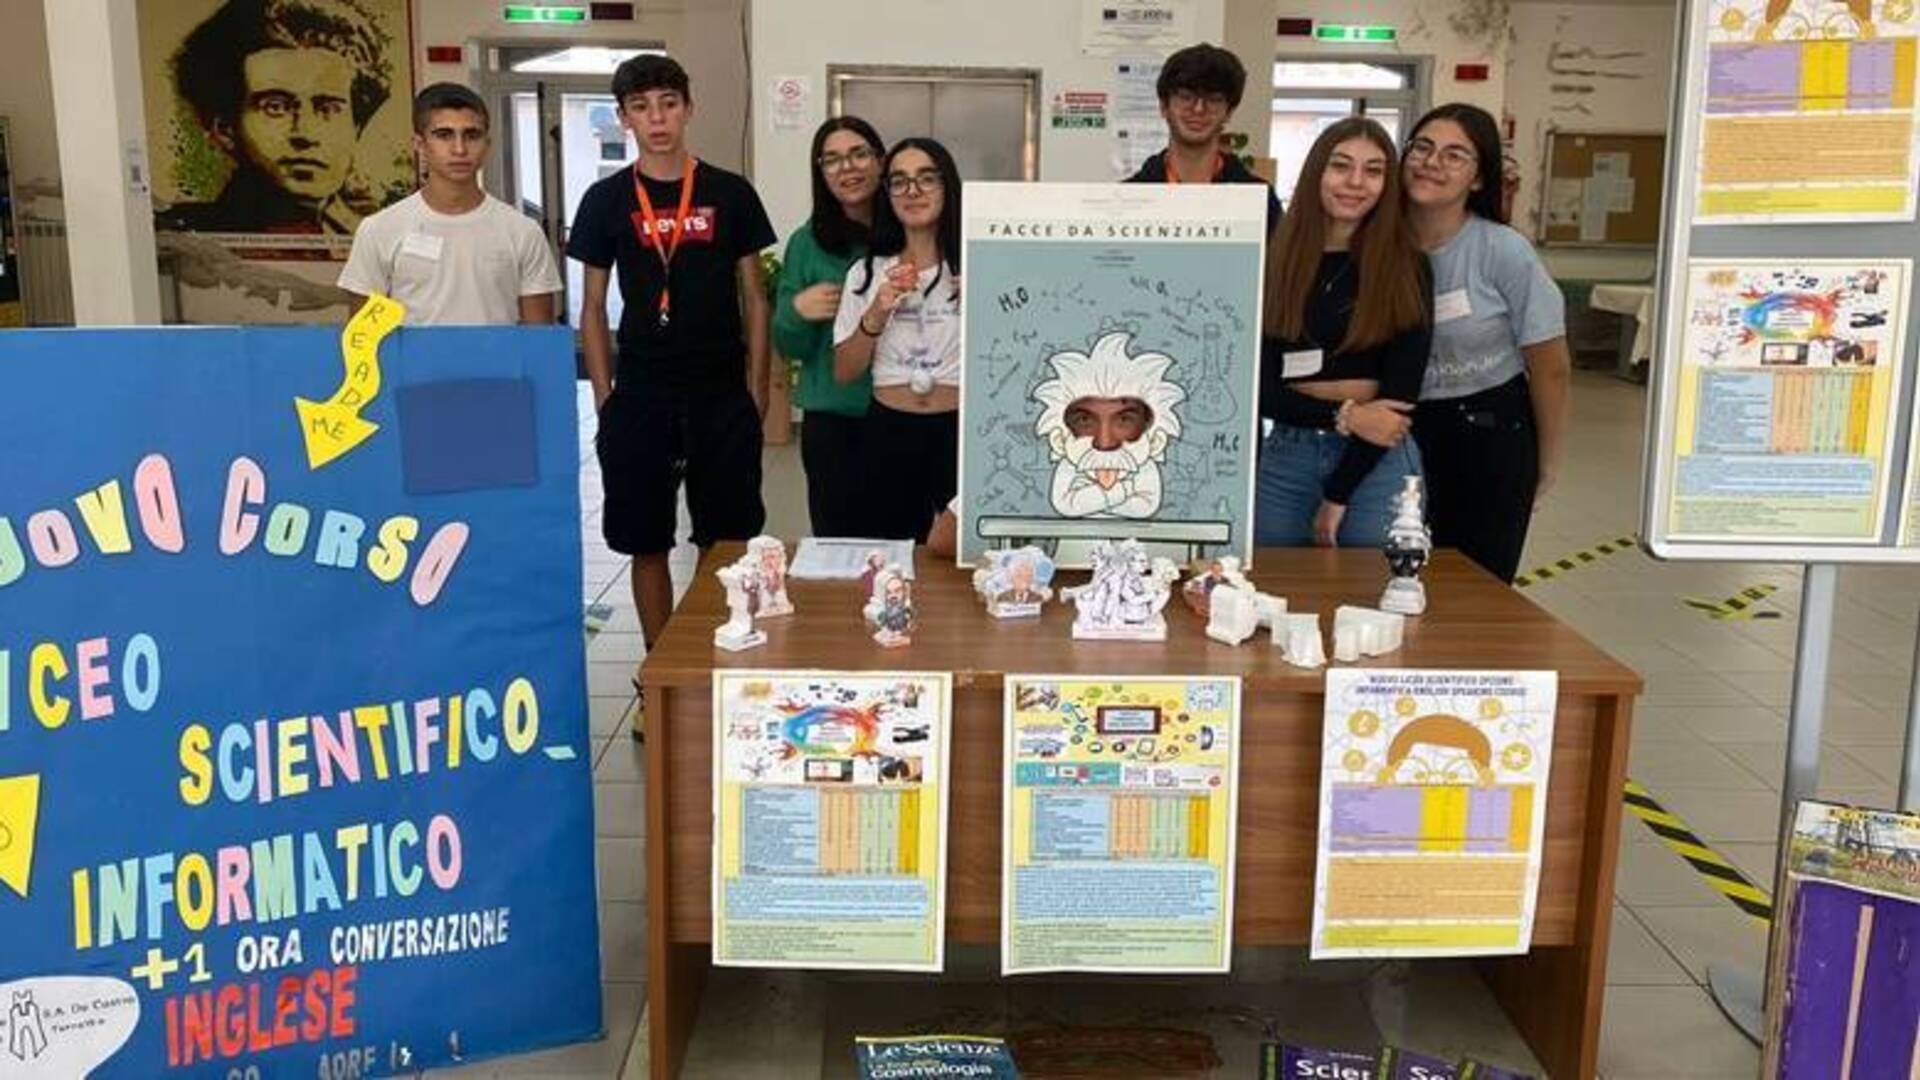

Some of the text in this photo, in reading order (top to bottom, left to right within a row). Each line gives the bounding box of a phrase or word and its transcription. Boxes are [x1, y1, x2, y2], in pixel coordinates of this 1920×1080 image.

[988, 223, 1232, 239] FACCE DA SCIENZIATI
[341, 303, 385, 406] READ
[311, 416, 347, 441] ME
[218, 456, 470, 606] CORSO
[71, 814, 463, 950] INFORMATICO
[130, 906, 512, 990] +1 ORA CONVERSAZIONE
[164, 965, 360, 1068] INGLESE
